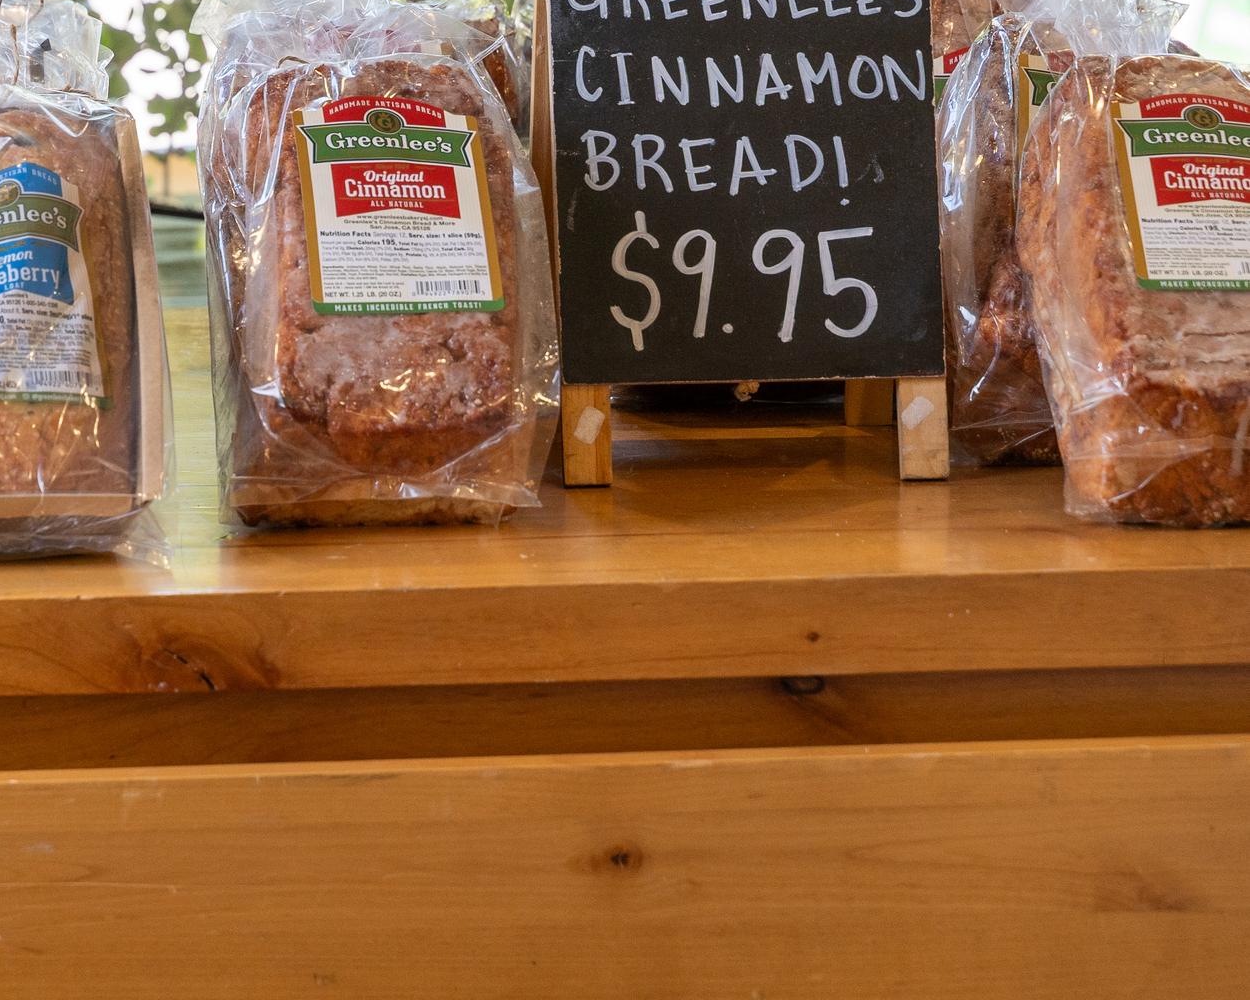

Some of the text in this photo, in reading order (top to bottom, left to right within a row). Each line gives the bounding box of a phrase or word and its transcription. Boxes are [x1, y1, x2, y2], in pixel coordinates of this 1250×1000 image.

[575, 45, 927, 108] CINNAMON
[328, 99, 442, 120] HANDMADE ARTISAN BREAD
[1145, 97, 1188, 111] HANDMADE
[1191, 97, 1229, 108] ARTISAN
[325, 132, 452, 154] Greenlee's
[580, 128, 850, 206] BREAD!
[1182, 163, 1245, 177] Original
[363, 170, 424, 185] Original
[344, 178, 447, 199] Cinnamon
[1209, 191, 1245, 199] NATURAL
[370, 200, 424, 209] ALL NATURAL
[609, 210, 879, 352] $9.95
[334, 301, 482, 312] MAKES INCREDIBLE FRENCH TOAST!
